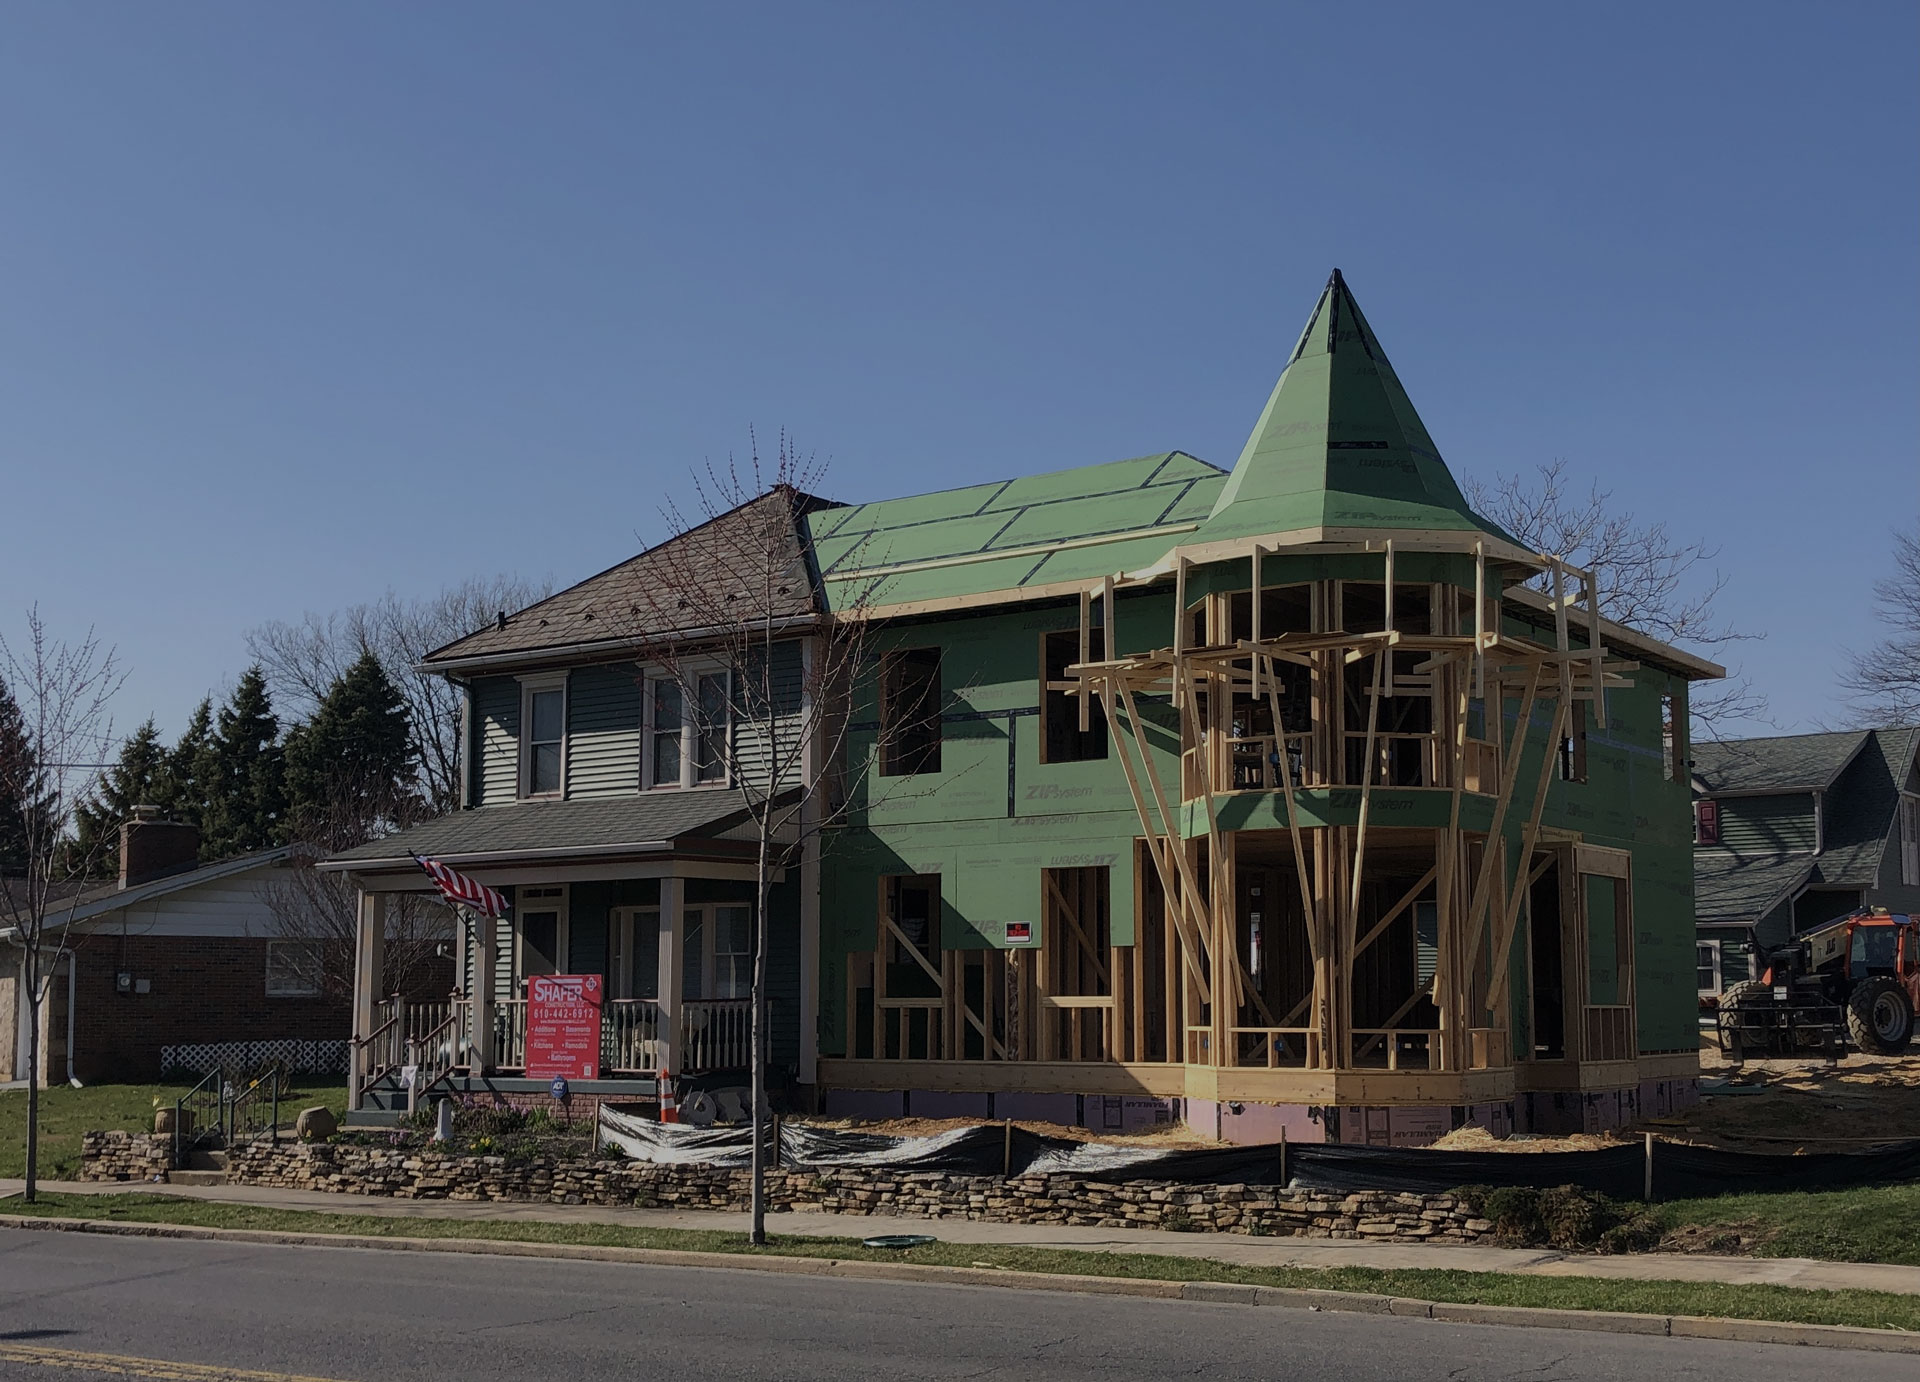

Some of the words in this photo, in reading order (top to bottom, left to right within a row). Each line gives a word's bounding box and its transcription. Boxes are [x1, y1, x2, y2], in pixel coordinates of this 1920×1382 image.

[534, 979, 583, 1001] SHAFER
[534, 1008, 593, 1018] 610-442-6912
[553, 1082, 564, 1090] ADT
